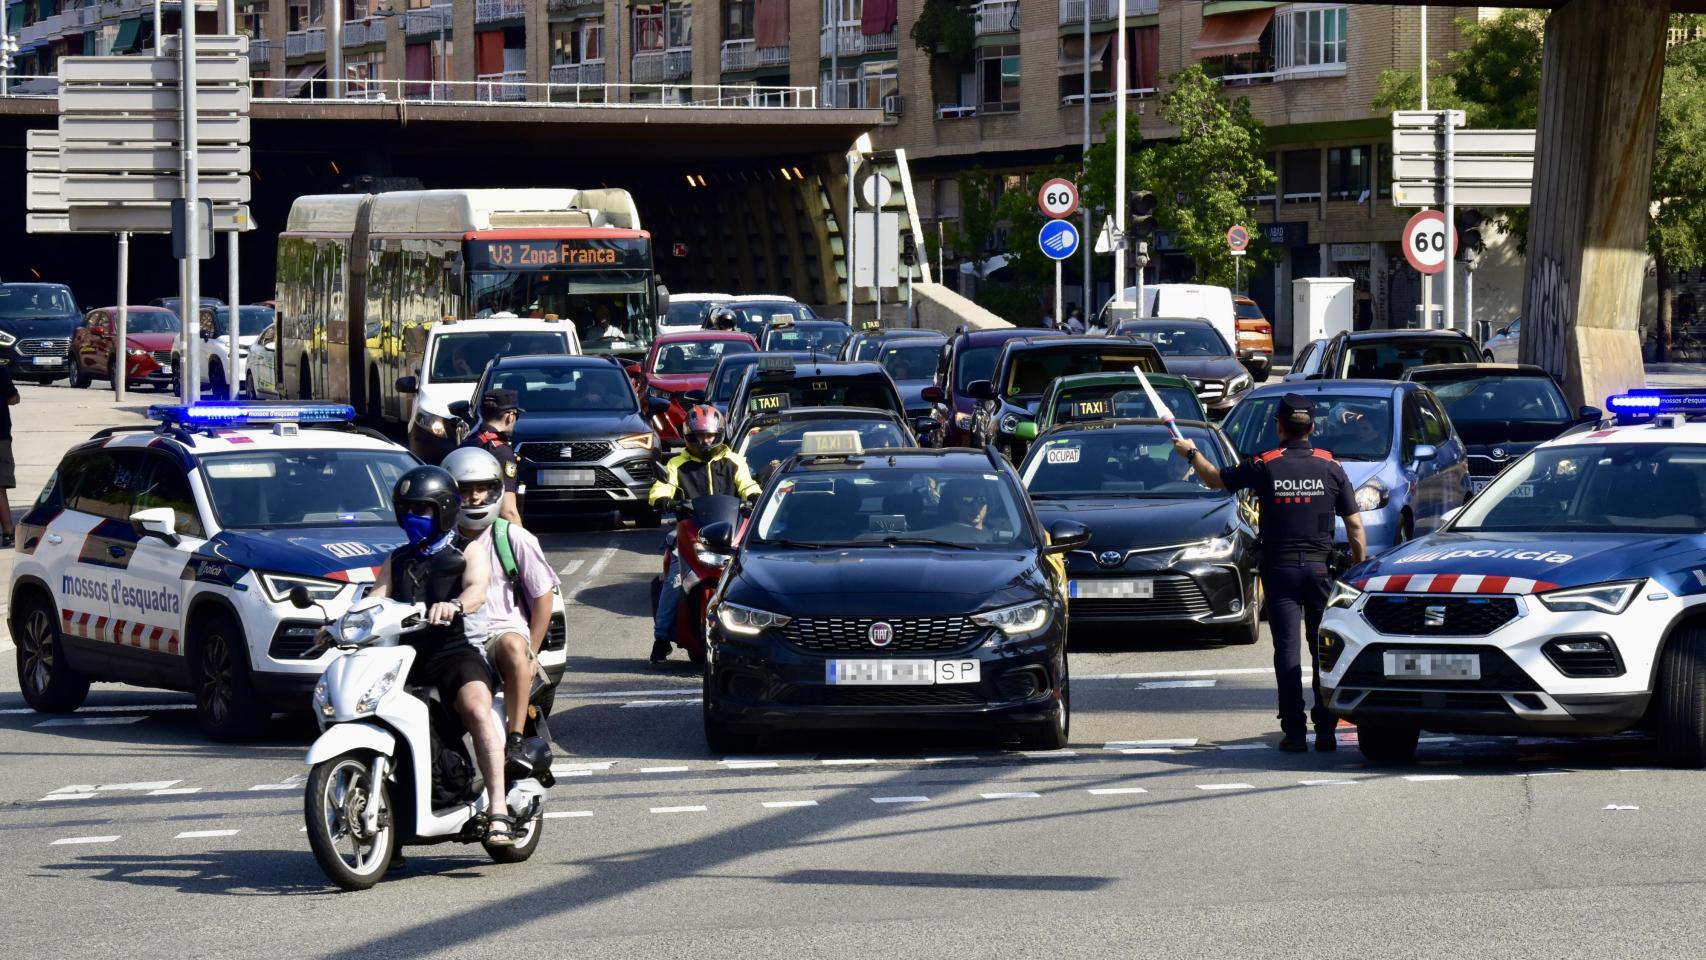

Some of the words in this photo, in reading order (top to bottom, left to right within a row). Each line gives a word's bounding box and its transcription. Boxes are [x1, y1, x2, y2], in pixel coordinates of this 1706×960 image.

[1047, 192, 1069, 205] 60
[1415, 232, 1445, 252] 60
[519, 244, 557, 264] Zona
[561, 244, 615, 264] Franca
[867, 320, 879, 328] TAXI
[758, 397, 779, 409] TAXI
[1080, 402, 1103, 414] TAXI
[816, 436, 840, 450] TAXI
[1049, 450, 1078, 462] OCUPAT
[1274, 479, 1325, 491] POLICIA
[1440, 548, 1574, 564] policia
[62, 574, 109, 602] mossos
[111, 578, 180, 615] d'esquadra
[873, 629, 888, 641] FIAT
